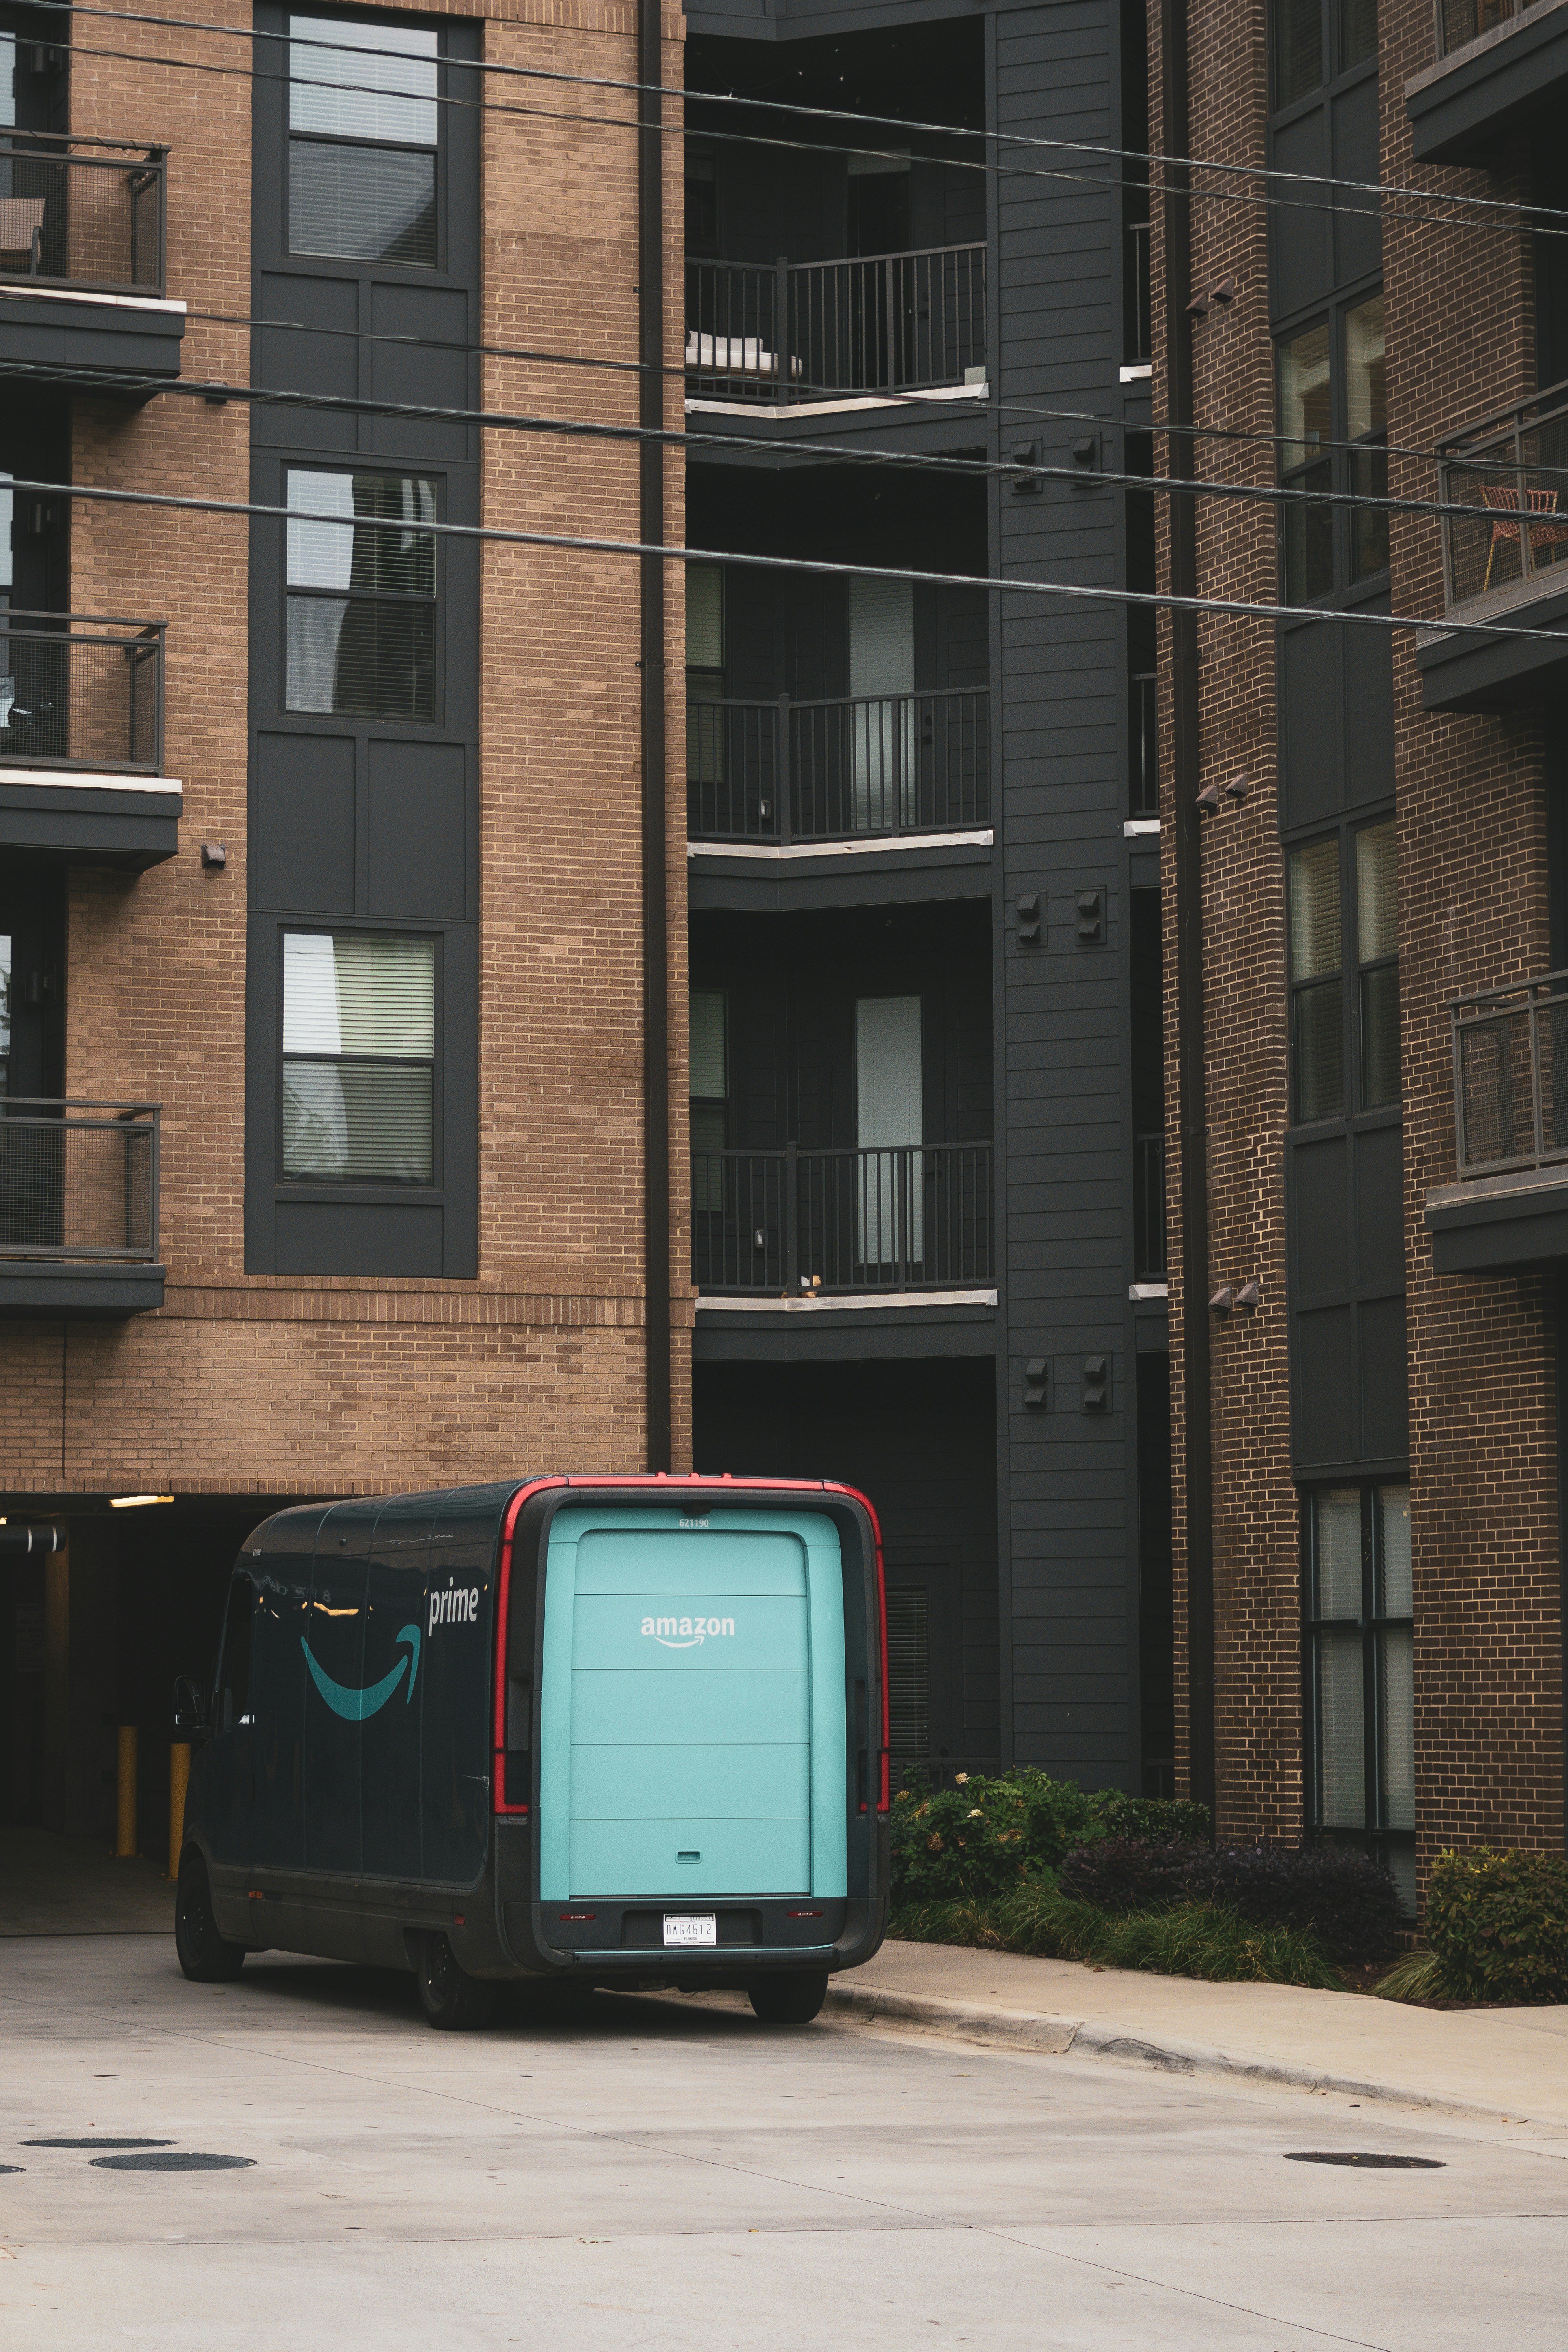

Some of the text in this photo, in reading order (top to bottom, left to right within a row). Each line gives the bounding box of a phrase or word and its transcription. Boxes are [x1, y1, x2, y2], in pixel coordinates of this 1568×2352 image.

[679, 1518, 709, 1527] 621190
[429, 1576, 478, 1636] prime
[641, 1617, 735, 1636] amazon
[667, 1924, 711, 1935] DMG4612
